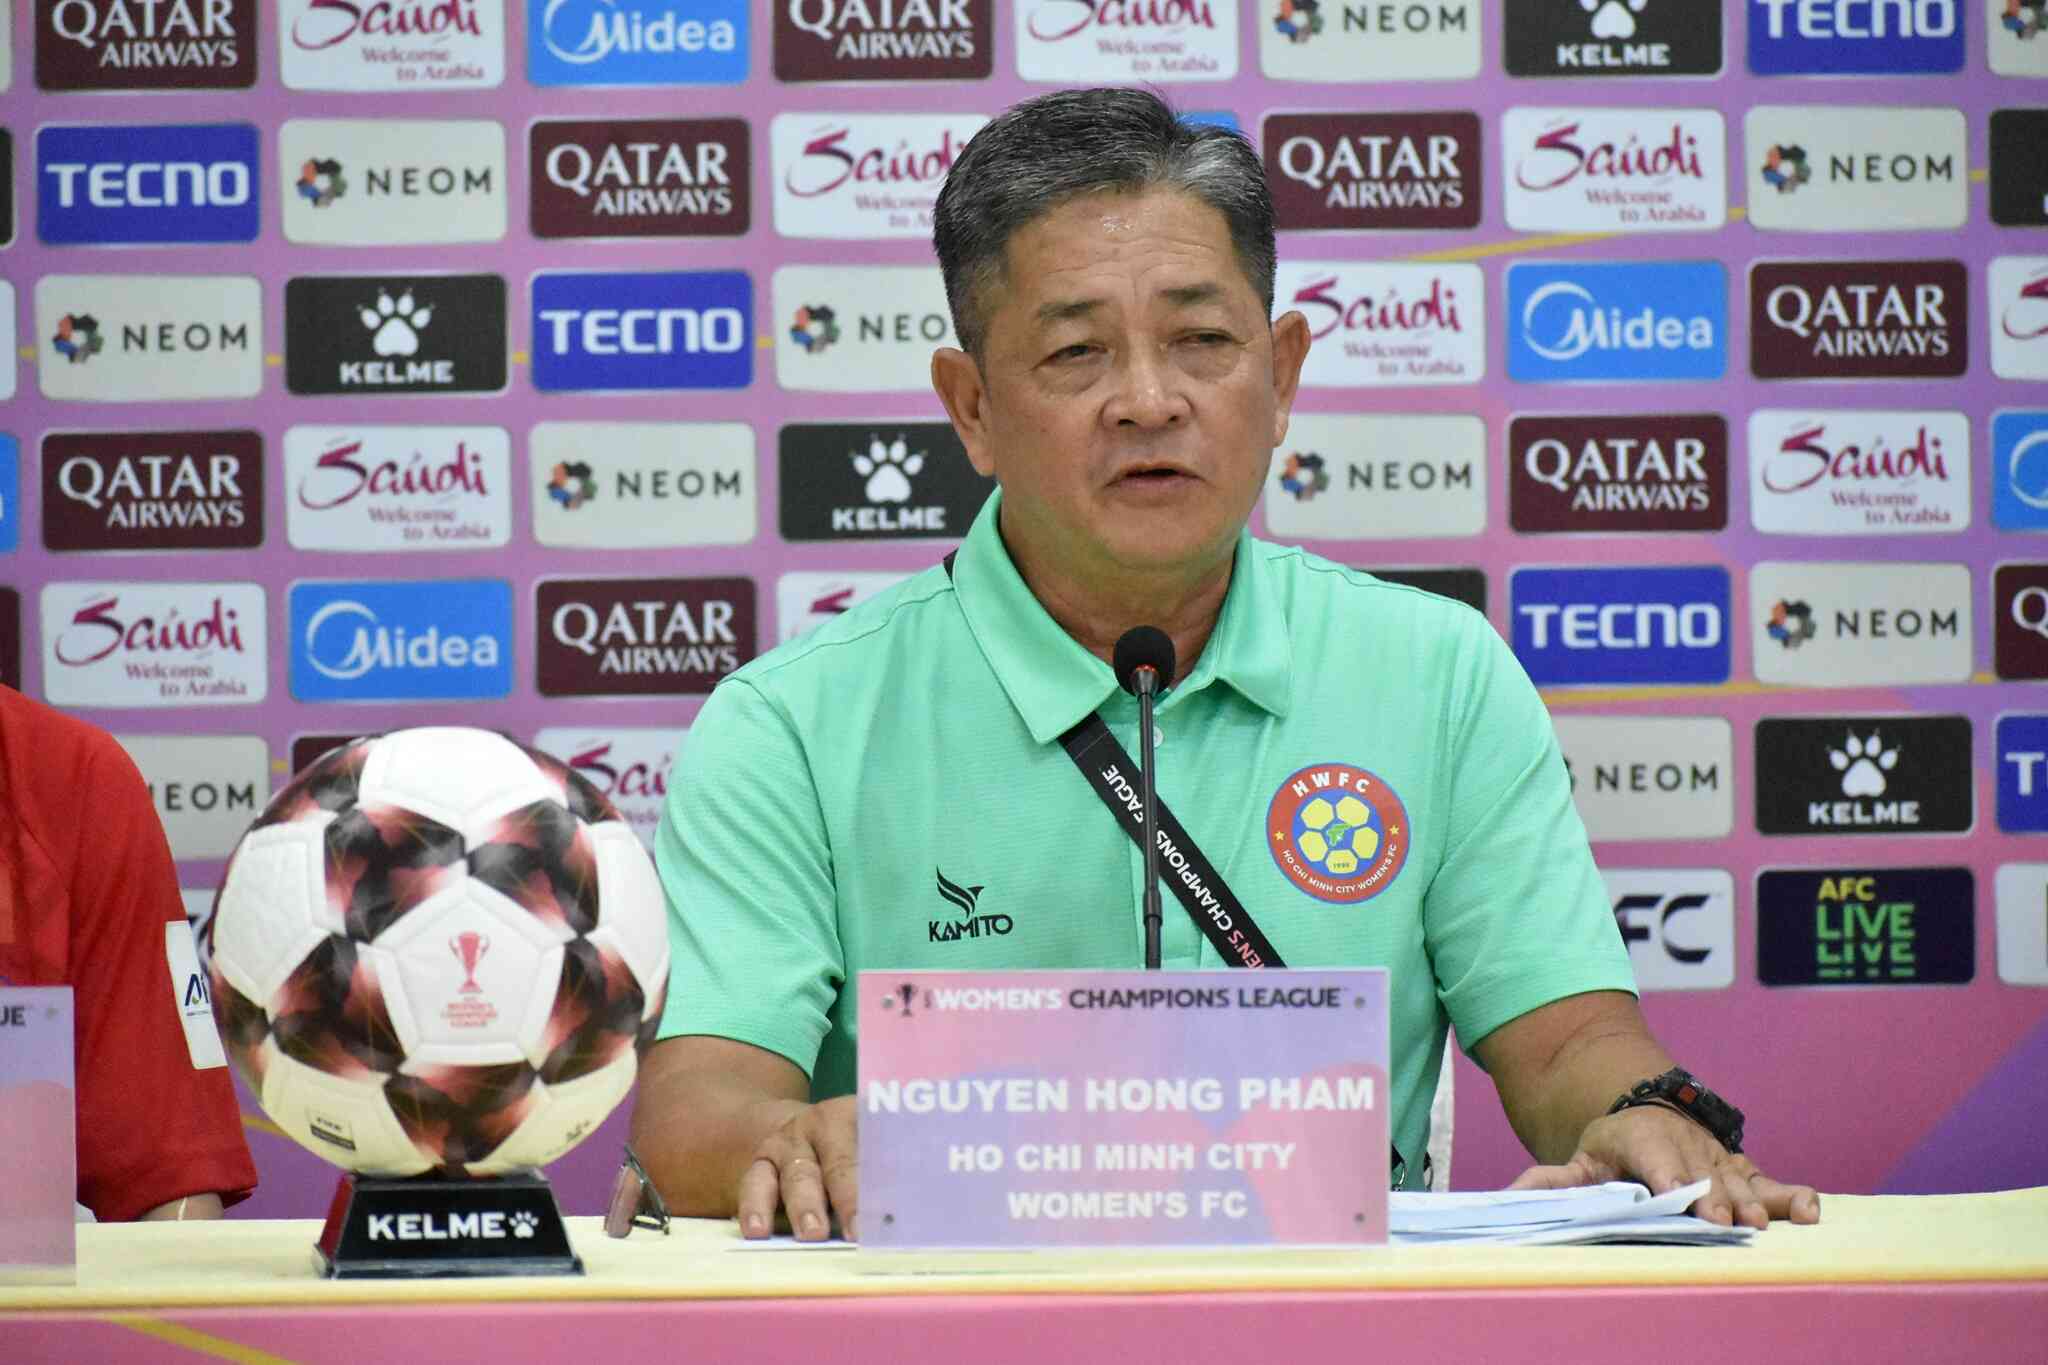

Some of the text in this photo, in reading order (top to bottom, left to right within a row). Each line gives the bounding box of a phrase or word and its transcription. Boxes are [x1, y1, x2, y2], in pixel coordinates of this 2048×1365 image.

[52, 0, 237, 46] QATAR
[789, 0, 973, 40] QATAR
[1343, 4, 1467, 32] NEOM
[1759, 0, 1955, 39] TECNO
[577, 18, 735, 53] Midea
[837, 32, 975, 59] AIRWAYS
[100, 41, 238, 67] AIRWAYS
[1557, 44, 1671, 67] KELME
[546, 143, 730, 196] QATAR
[1279, 135, 1461, 188] QATAR
[1831, 154, 1953, 181] NEOM
[45, 162, 249, 207] TECNO
[367, 167, 492, 194] NEOM
[1326, 181, 1463, 208] AIRWAYS
[593, 187, 732, 216] AIRWAYS
[1766, 284, 1947, 336] QATAR
[122, 324, 248, 351] NEOM
[539, 308, 743, 354] TECNO
[859, 314, 947, 341] NEO
[1558, 305, 1713, 349] Midea
[1813, 328, 1949, 357] AIRWAYS
[340, 360, 453, 384] KELME
[1348, 462, 1472, 490] NEOM
[1525, 439, 1707, 490] QATAR
[59, 455, 243, 508] QATAR
[617, 470, 741, 498] NEOM
[1572, 484, 1709, 512] AIRWAYS
[106, 502, 245, 529] AIRWAYS
[832, 507, 946, 531] KELME
[553, 601, 736, 655] QATAR
[1519, 604, 1722, 649] TECNO
[1835, 609, 1958, 638] NEOM
[343, 627, 498, 669] Midea
[600, 646, 738, 675] AIRWAYS
[1595, 764, 1719, 793] NEOM
[151, 783, 255, 811] EOM
[1809, 802, 1920, 825] KELME
[1156, 829, 1233, 931] CHAMPIONS
[1283, 849, 1295, 864] HO
[1293, 864, 1308, 880] CHI
[1308, 876, 1334, 893] MINH
[1336, 884, 1357, 893] CITY
[1387, 843, 1397, 858] FC
[1818, 877, 1876, 901] AFC
[928, 914, 1014, 942] KAMITO
[1613, 894, 1712, 964] FC
[1816, 903, 1915, 939] LIVE
[934, 988, 1062, 1011] WOMEN'S
[1069, 988, 1229, 1009] CHAMPIONS
[1238, 988, 1341, 1008] LEAGUE
[868, 1077, 1375, 1113] NGUYEN HONG PHAM
[948, 1144, 1297, 1171] HO CHI MINH CITY
[1007, 1192, 1248, 1219] WOMEN'S FC
[368, 1212, 507, 1241] KELME
